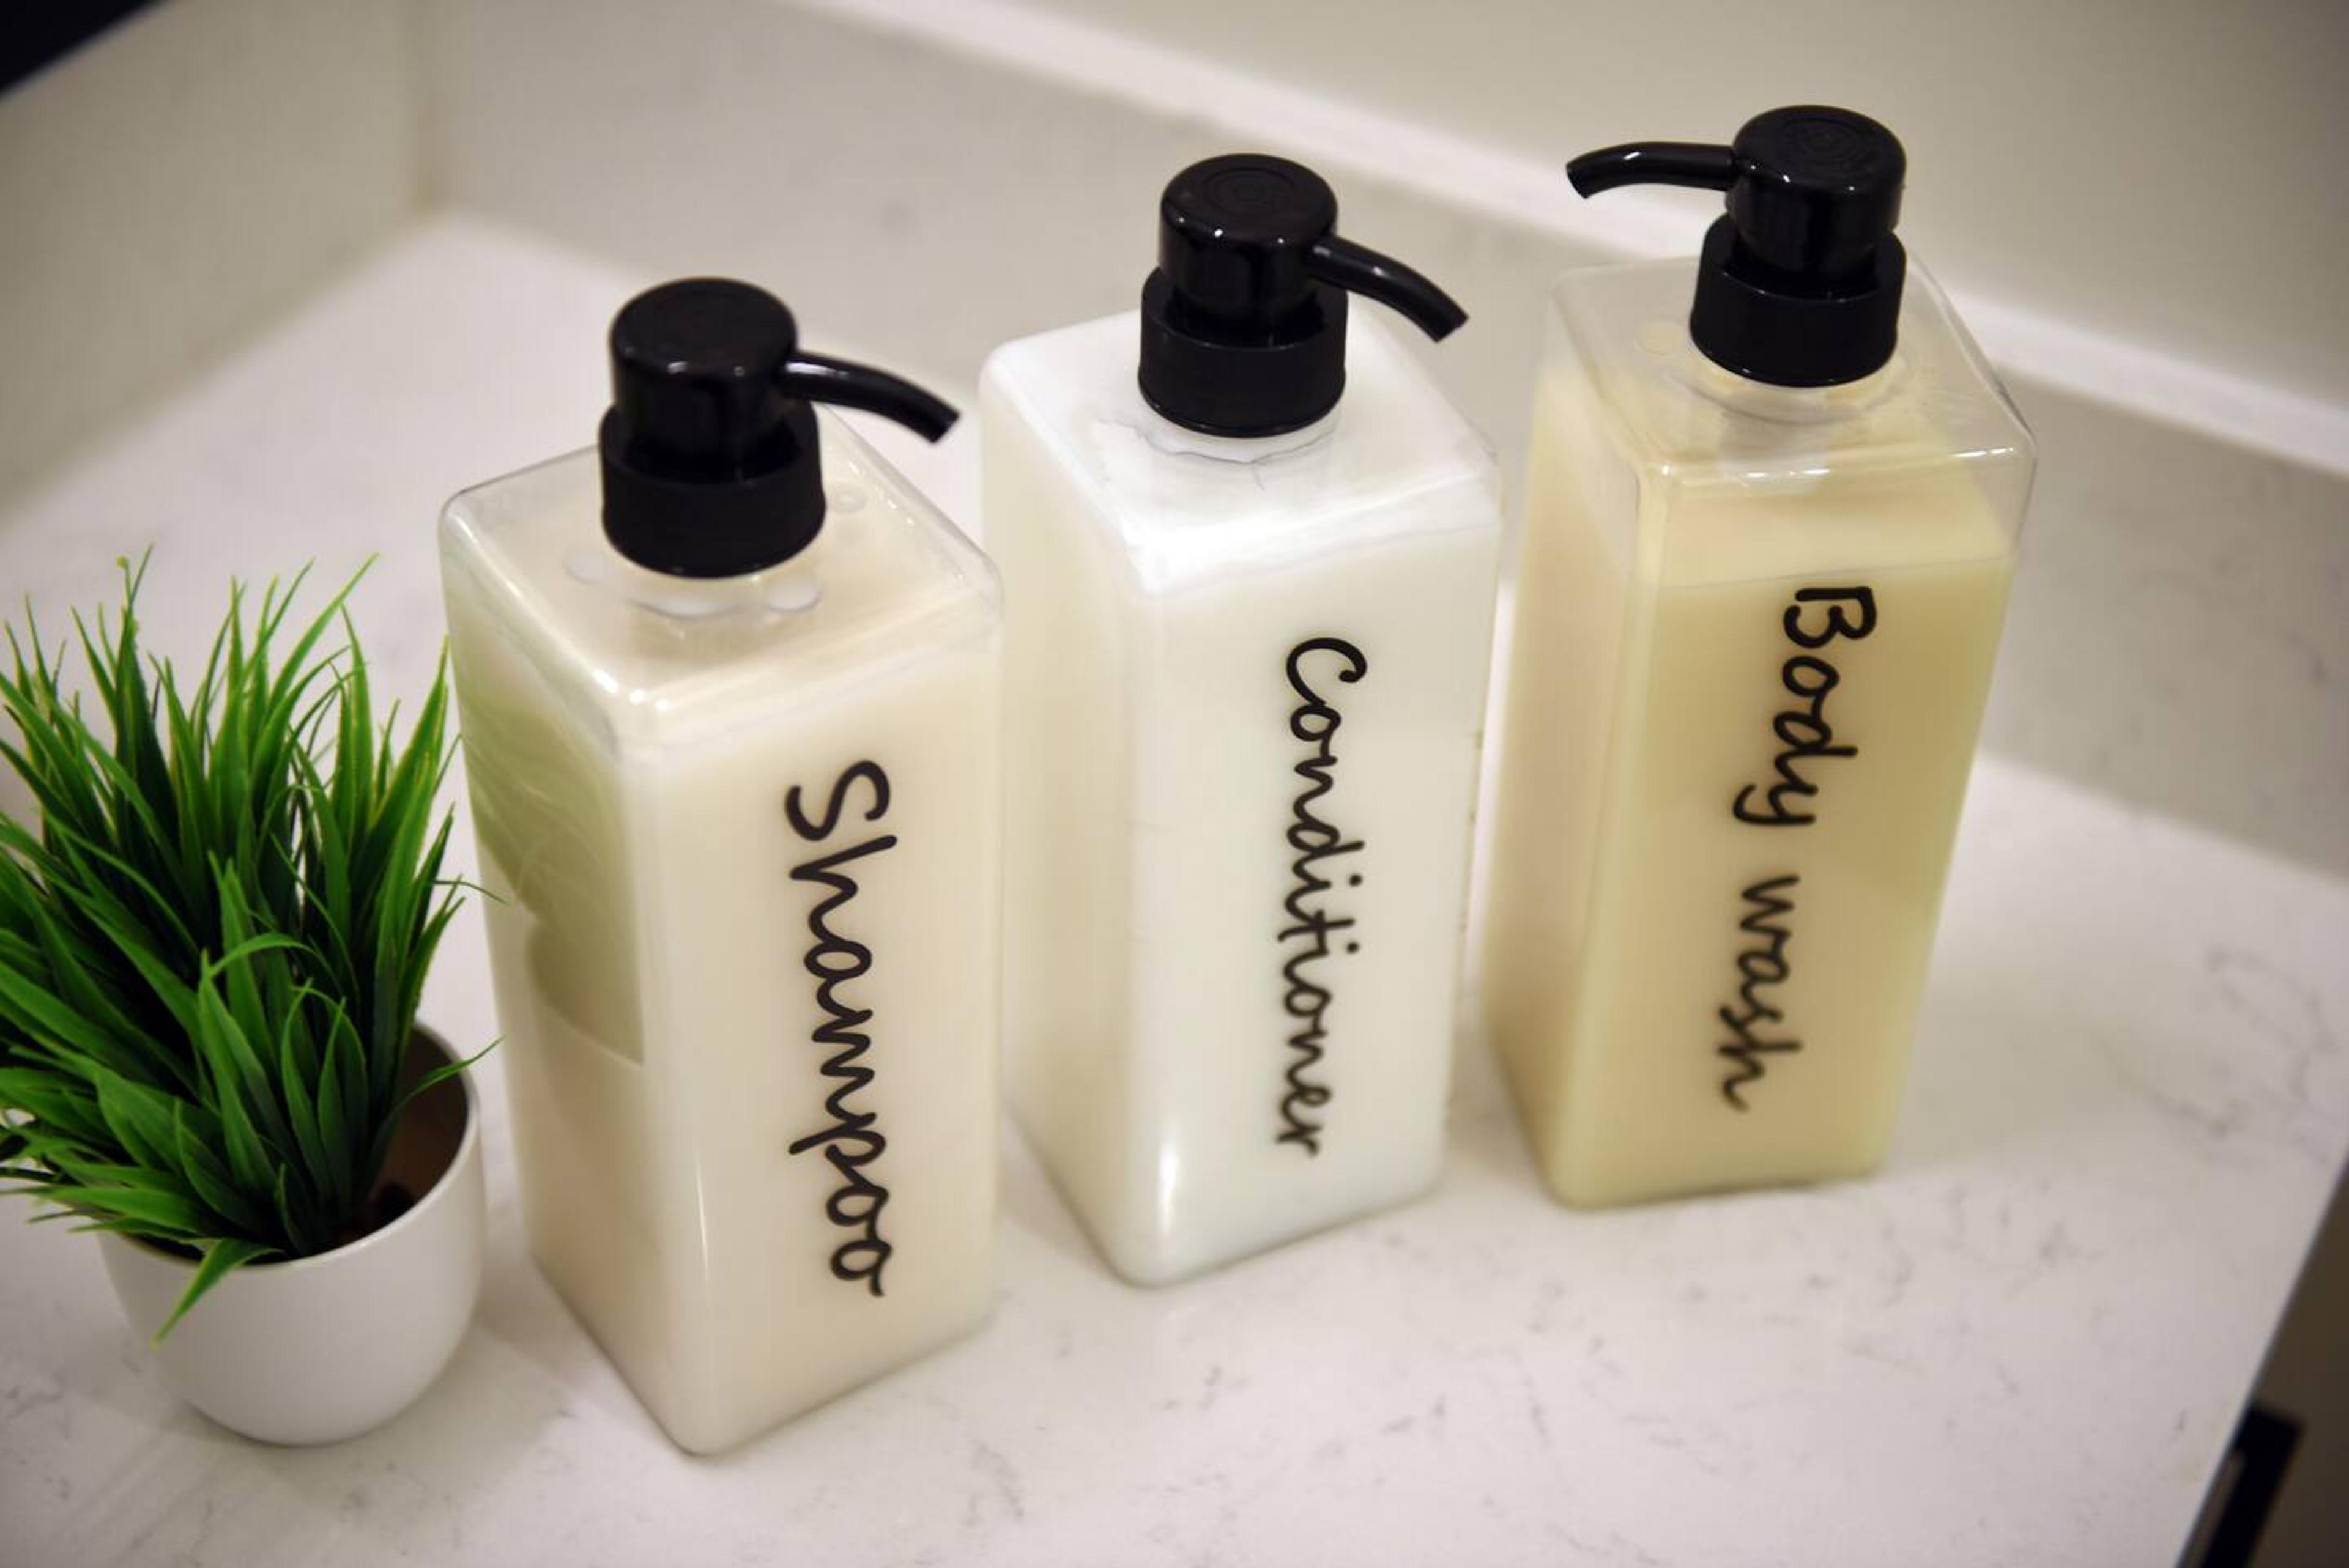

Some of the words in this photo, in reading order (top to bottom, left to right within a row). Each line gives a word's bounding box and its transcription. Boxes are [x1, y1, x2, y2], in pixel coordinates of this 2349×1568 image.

[1277, 637, 1368, 1156] Conditioner
[1732, 585, 1878, 828] Body
[784, 760, 897, 1297] Shampoo
[1715, 873, 1803, 1111] wash
